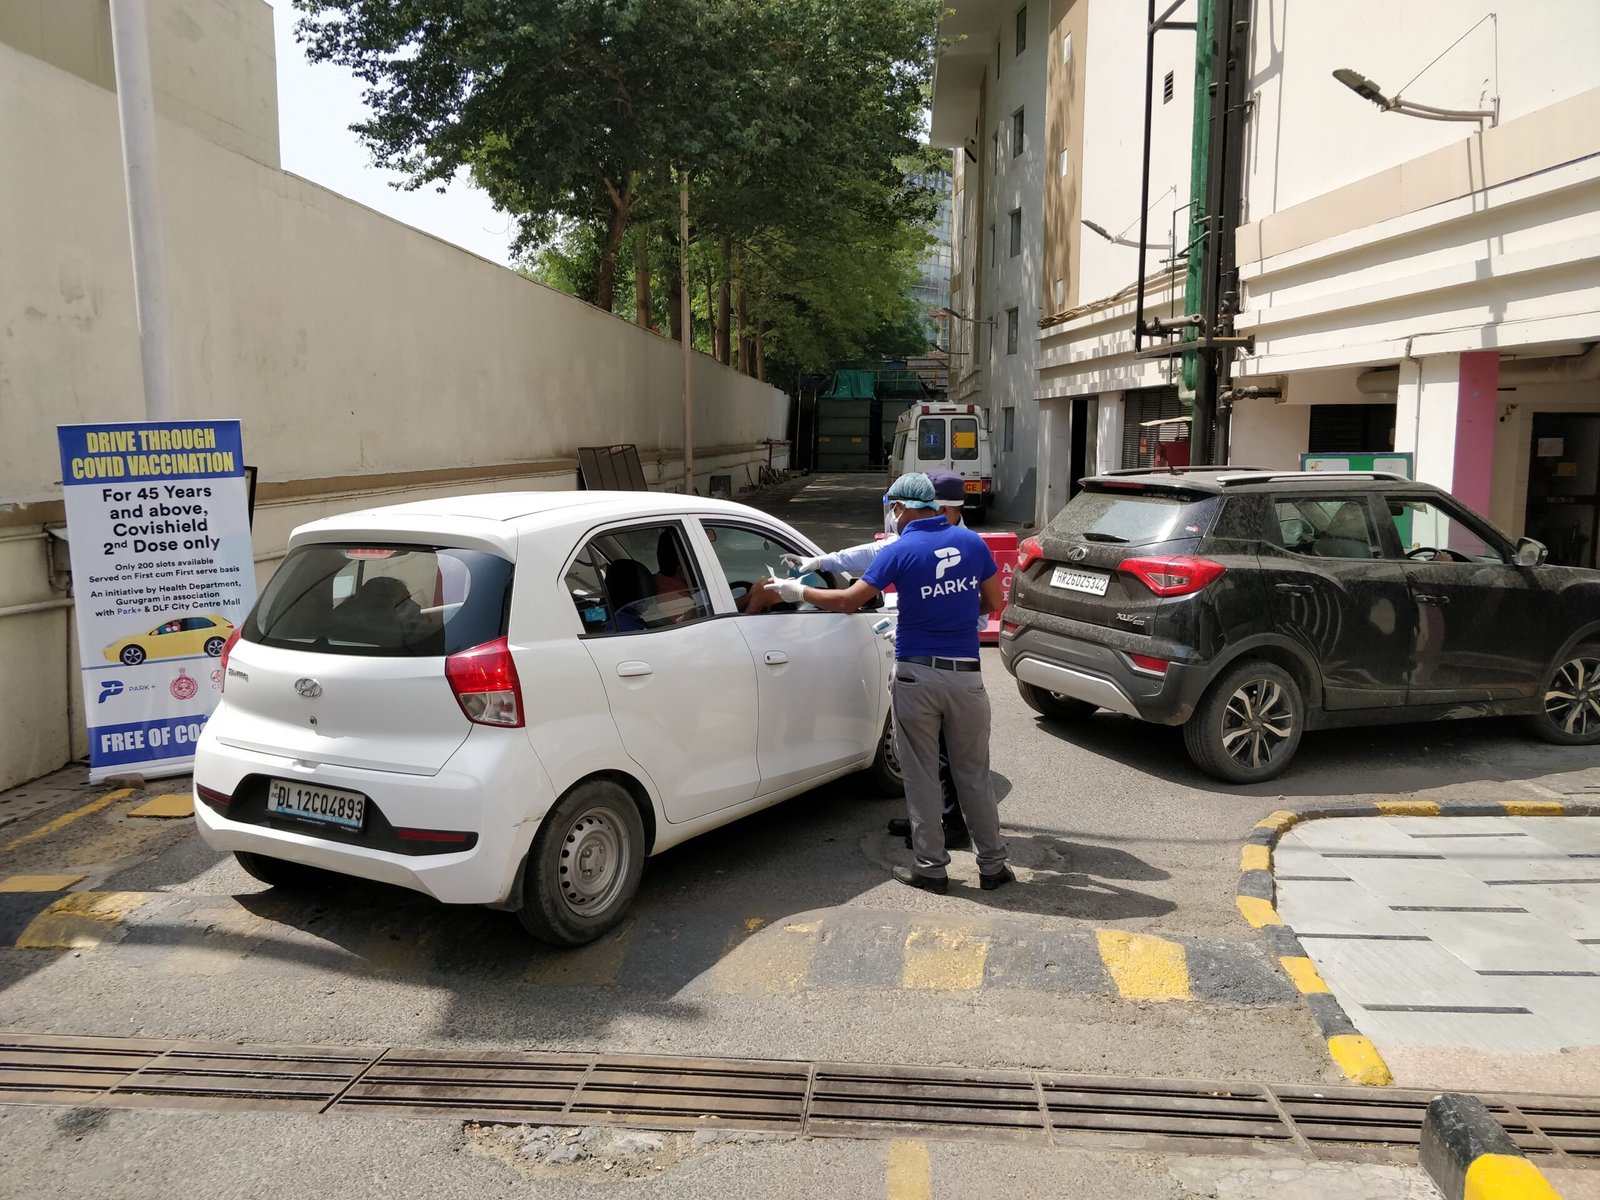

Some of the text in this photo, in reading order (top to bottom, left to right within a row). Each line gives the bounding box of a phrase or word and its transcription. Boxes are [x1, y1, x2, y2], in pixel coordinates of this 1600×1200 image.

[86, 428, 216, 454] DRIVE THROUGH
[71, 451, 235, 480] COVID VACCINATION
[102, 485, 212, 502] For 45 Years
[110, 503, 209, 519] and above,
[113, 518, 208, 537] Covishield
[103, 535, 220, 555] 2nd Dose only
[89, 565, 240, 583] Served on First cum First serve basis
[115, 563, 135, 572] Only
[155, 560, 176, 569] slots
[177, 557, 214, 567] available
[90, 580, 242, 598] An initiative by Health Department,
[920, 576, 978, 599] PARK+
[95, 598, 241, 617] with Park+ & DLF City Centre Mall
[116, 591, 220, 606] Gurugram in association
[101, 730, 145, 753] FREE
[148, 726, 171, 747] OF
